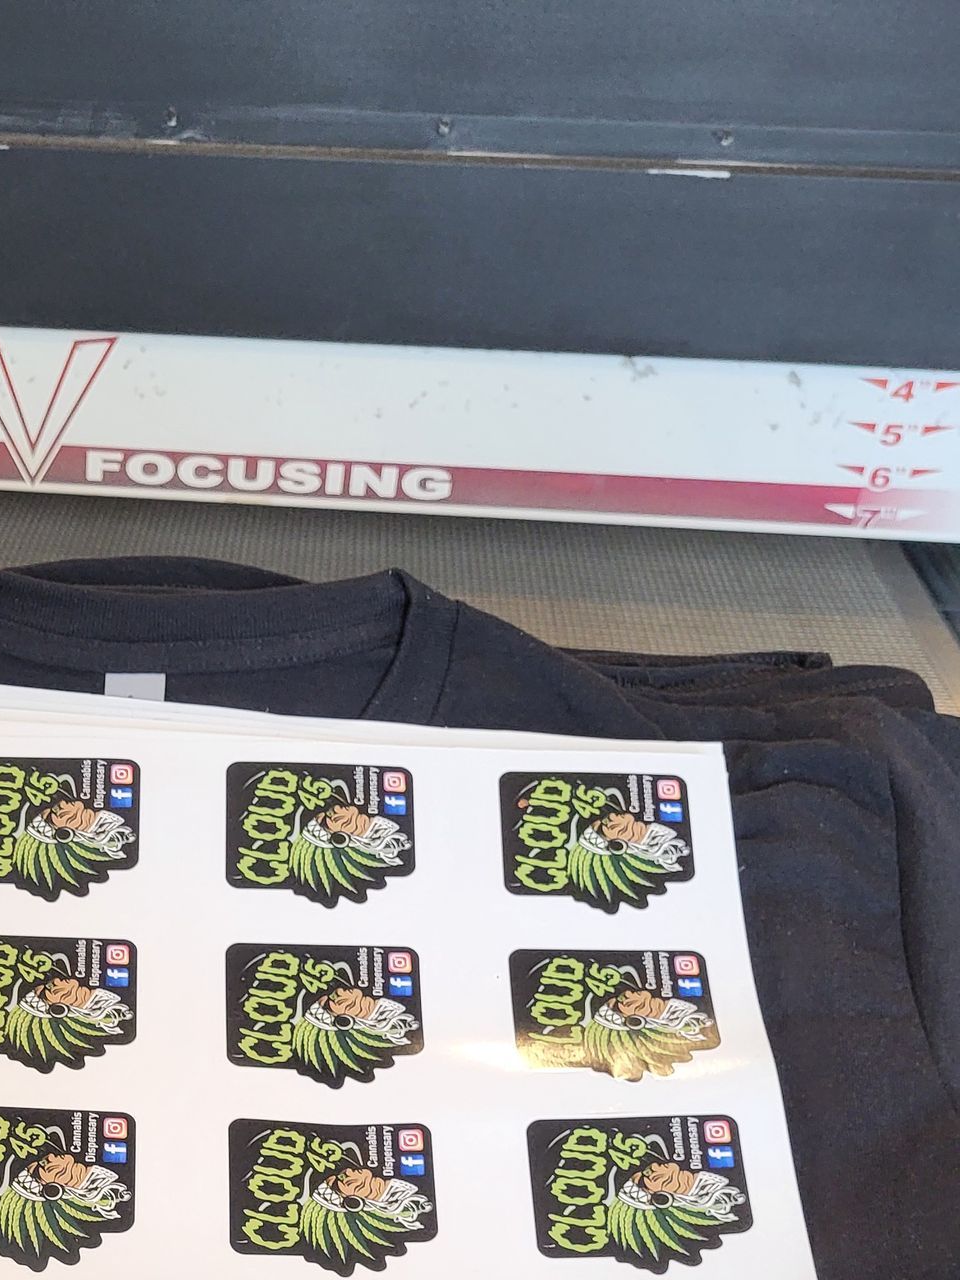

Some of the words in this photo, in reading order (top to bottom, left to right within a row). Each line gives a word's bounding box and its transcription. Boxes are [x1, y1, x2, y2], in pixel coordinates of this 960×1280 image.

[85, 449, 453, 501] FOCUSING
[25, 771, 58, 806] 45
[80, 760, 91, 799] Cannabis
[94, 760, 108, 808] Dispensary
[298, 776, 332, 810] 45
[572, 784, 606, 818] 45
[237, 770, 298, 884] CLOUD
[514, 778, 571, 892] CLOUD
[18, 950, 52, 983] 45
[75, 940, 86, 978] Cannabis
[90, 940, 102, 986] Dispensary
[299, 958, 335, 993] 45
[358, 948, 367, 987] Cannabis
[373, 948, 384, 996] Dispensary
[585, 963, 621, 997] 45
[238, 952, 299, 1064] CLOUD
[528, 957, 584, 1066] LOUD
[9, 1122, 46, 1159] 45
[70, 1112, 82, 1153] Cannabis
[85, 1113, 99, 1163] Dispensary
[367, 1126, 377, 1167] Cannabis
[383, 1126, 393, 1176] Dispensary
[608, 1132, 647, 1170] 45
[669, 1117, 685, 1161] Cannabis
[687, 1117, 702, 1169] Dispensary
[306, 1137, 342, 1173] 45
[242, 1129, 306, 1250] CLOUD
[548, 1128, 609, 1253] CLOUD
